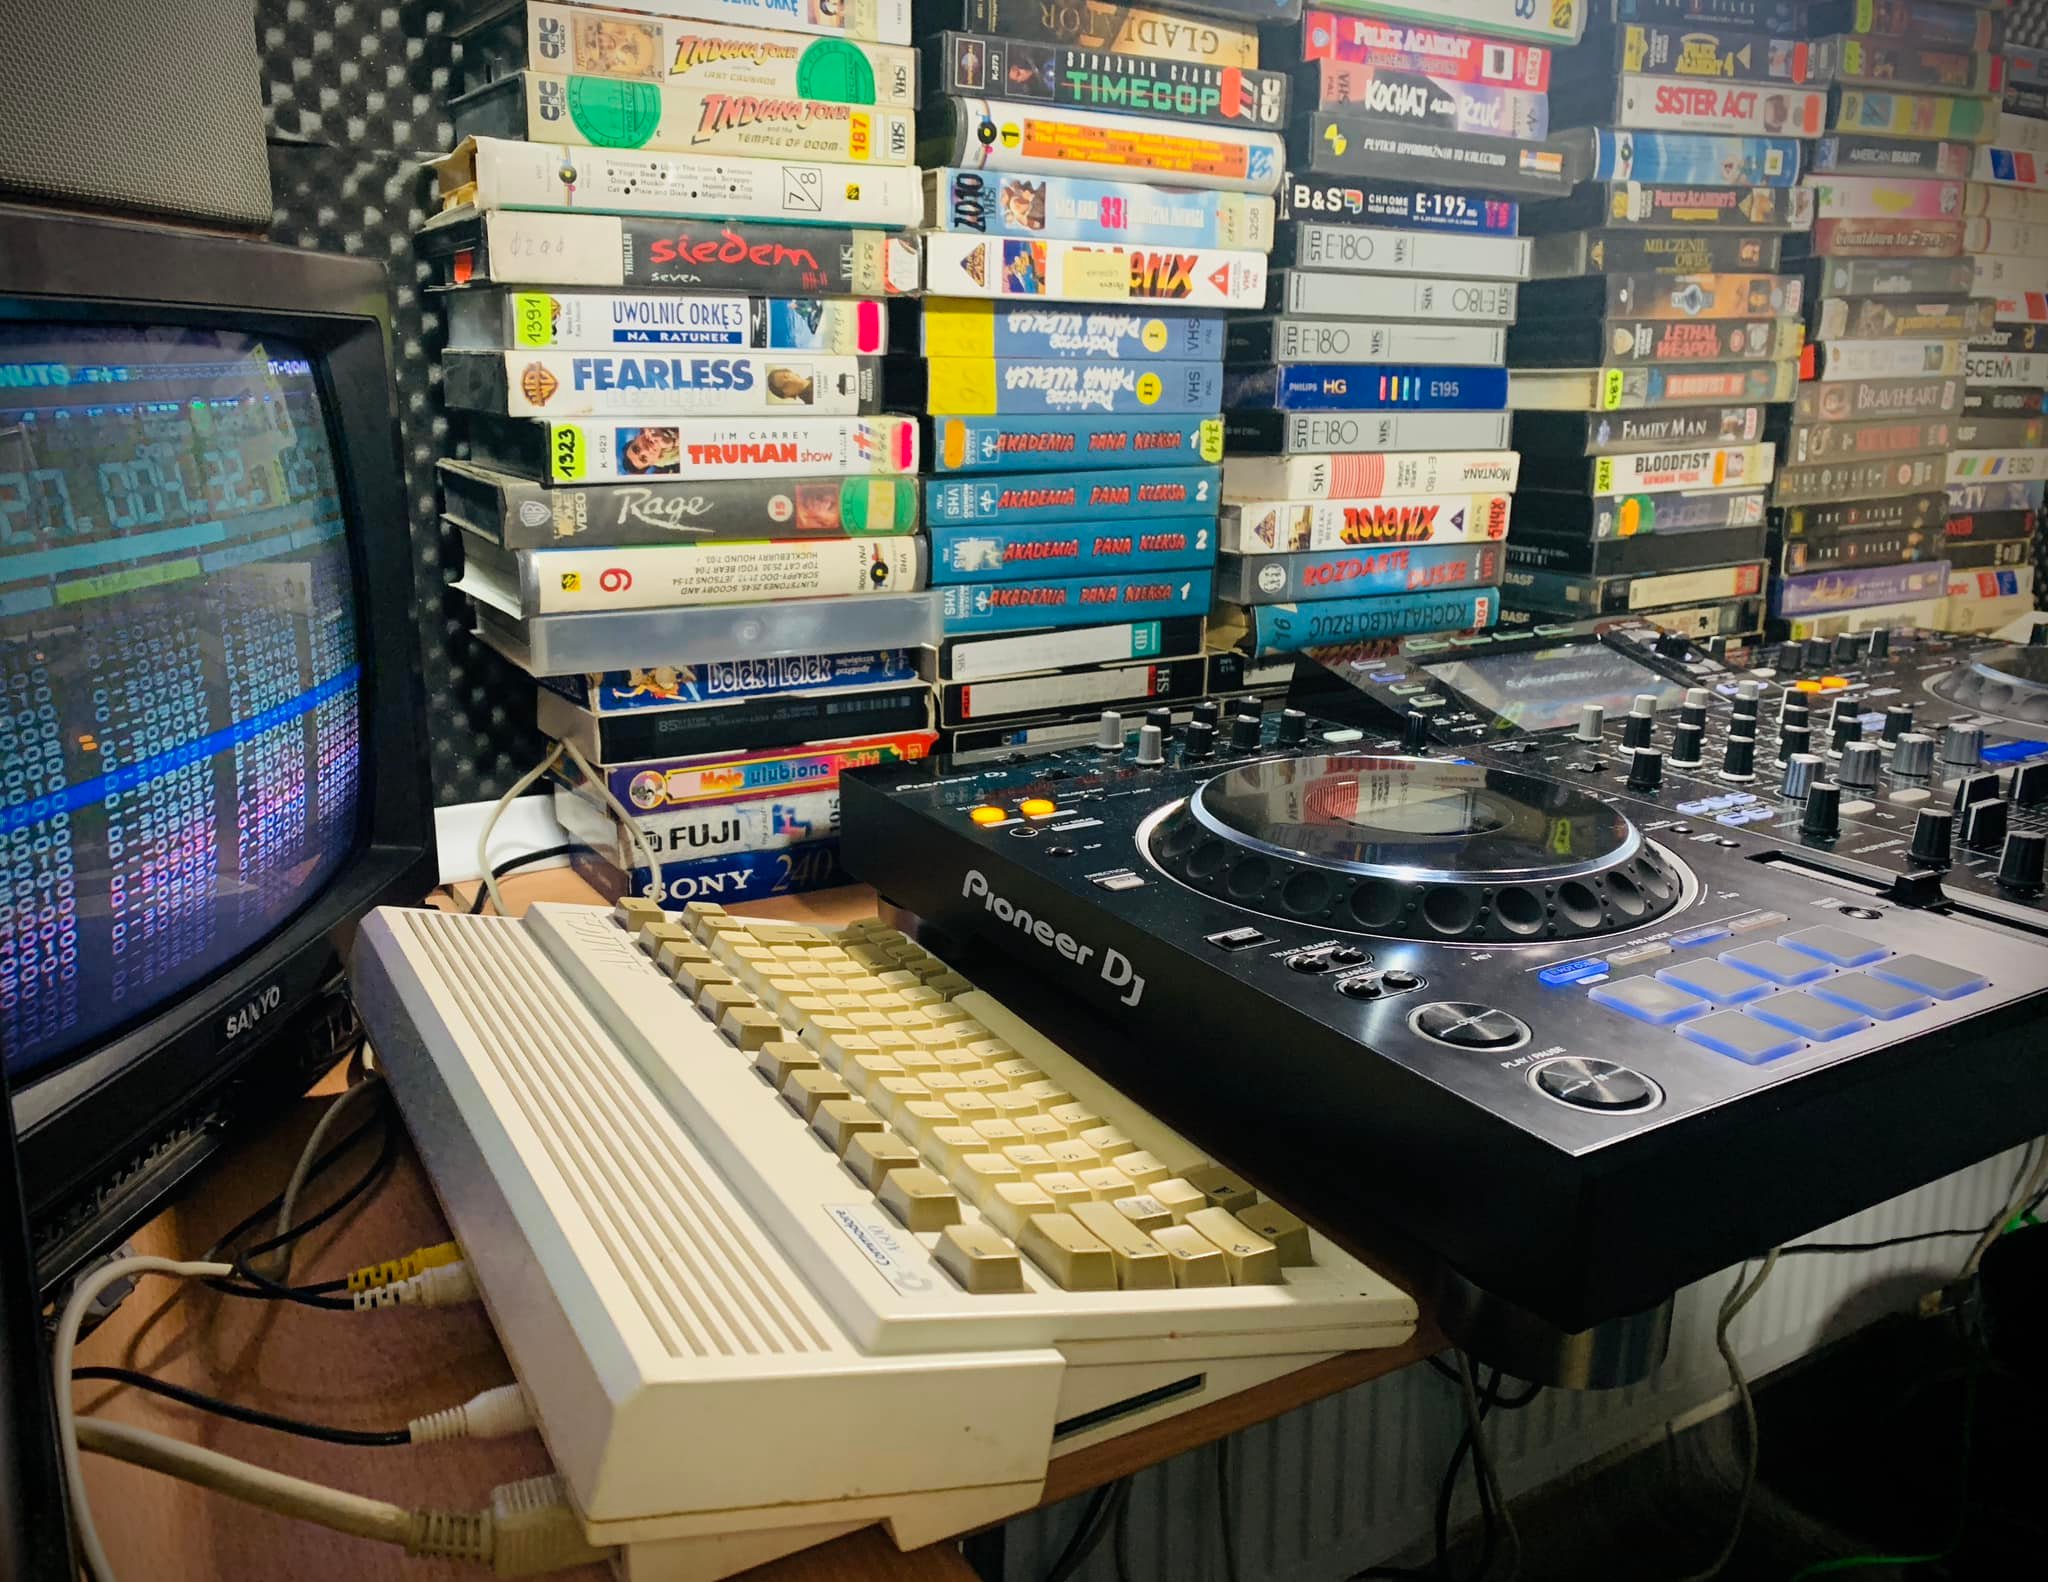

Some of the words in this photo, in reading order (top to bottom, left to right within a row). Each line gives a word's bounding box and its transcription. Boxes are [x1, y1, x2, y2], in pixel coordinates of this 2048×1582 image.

[1354, 21, 1403, 50] POLICE
[1404, 30, 1472, 59] ACADEMY
[669, 35, 758, 75] INDIANA
[758, 43, 799, 66] JONES
[893, 65, 906, 97] VHS
[1066, 71, 1221, 114] TIMECOP
[1365, 80, 1428, 117] KOCHAJ
[1655, 86, 1717, 116] SISTER
[1721, 90, 1758, 119] ACT
[692, 94, 800, 145] INDIANA
[798, 104, 851, 129] JONES
[738, 133, 781, 146] TEMPLE
[786, 135, 800, 147] OF
[852, 119, 867, 152] 187
[892, 122, 905, 153] VHS
[1294, 185, 1344, 212] B&S
[1368, 193, 1408, 206] CHROME
[623, 233, 632, 276] THRILLER
[651, 229, 819, 270] siedem
[1310, 230, 1321, 260] STD
[651, 272, 701, 283] seven
[732, 304, 743, 326] 3
[1498, 287, 1508, 315] STD
[525, 298, 542, 342] 1391
[1187, 318, 1200, 351] VHS
[1665, 324, 1717, 340] LETHAL
[627, 331, 649, 341] NA
[660, 332, 729, 343] RATUNEK
[1287, 326, 1298, 356] STD
[1656, 341, 1721, 358] WEAPON
[572, 357, 754, 392] FEARLESS
[1187, 371, 1201, 404] VHS
[1289, 382, 1317, 392] PHILIPS
[1323, 379, 1347, 394] HG
[1430, 381, 1459, 398] E195
[1858, 385, 1939, 408] BRAVEHEART
[713, 432, 737, 441] JIM
[750, 431, 809, 440] CARREY
[996, 432, 1075, 452] AKADEMIA
[1134, 431, 1183, 449] KLEKSA
[1297, 419, 1308, 448] STD
[1670, 418, 1708, 437] MAN
[558, 428, 576, 478] 1323
[688, 443, 798, 464] TRUMAN
[801, 450, 832, 463] show
[1635, 452, 1710, 473] BLOODFIST
[1312, 463, 1324, 493] VHS
[1464, 468, 1511, 481] MONTANA
[947, 486, 960, 515] VHS
[998, 488, 1075, 509] AKADEMIA
[1090, 486, 1130, 505] PANA
[1138, 484, 1187, 502] KLEKSA
[1196, 480, 1208, 502] 2
[575, 492, 588, 531] VIDEO
[612, 487, 715, 534] Rage
[1340, 504, 1440, 545] Asterix
[725, 555, 756, 563] HOUND
[1002, 540, 1079, 562] AKADEMIA
[1093, 537, 1132, 556] PANA
[1139, 533, 1186, 551] KLEKSA
[1195, 529, 1208, 550] 2
[695, 575, 734, 585] JETSONS
[712, 566, 735, 574] BEAR
[742, 564, 759, 573] YOGI
[1304, 551, 1410, 586] ROZDARTE
[1407, 561, 1468, 590] DUSZE
[1505, 573, 1534, 586] BASF
[701, 584, 737, 593] SCOOBY
[764, 581, 818, 591] FLINTSTONES
[989, 587, 1066, 608] AKADEMIA
[1080, 586, 1118, 605] PANA
[1124, 585, 1173, 603] KLEKSA
[944, 590, 956, 617] VHS
[1501, 610, 1530, 623] BASF
[1360, 610, 1397, 634] ALBO
[1401, 604, 1467, 634] KOCHAJ
[708, 657, 765, 693] Bolek
[780, 655, 831, 686] Lolek
[752, 762, 829, 784] ulubione
[896, 774, 978, 792] Pioneer
[670, 820, 741, 851] FUJI
[642, 869, 753, 902] SONY
[771, 849, 832, 892] 240
[962, 869, 1094, 965] Pioneer
[1099, 947, 1147, 1007] DJ
[226, 984, 281, 1040] SANYO
[1501, 1056, 1526, 1070] PLAY
